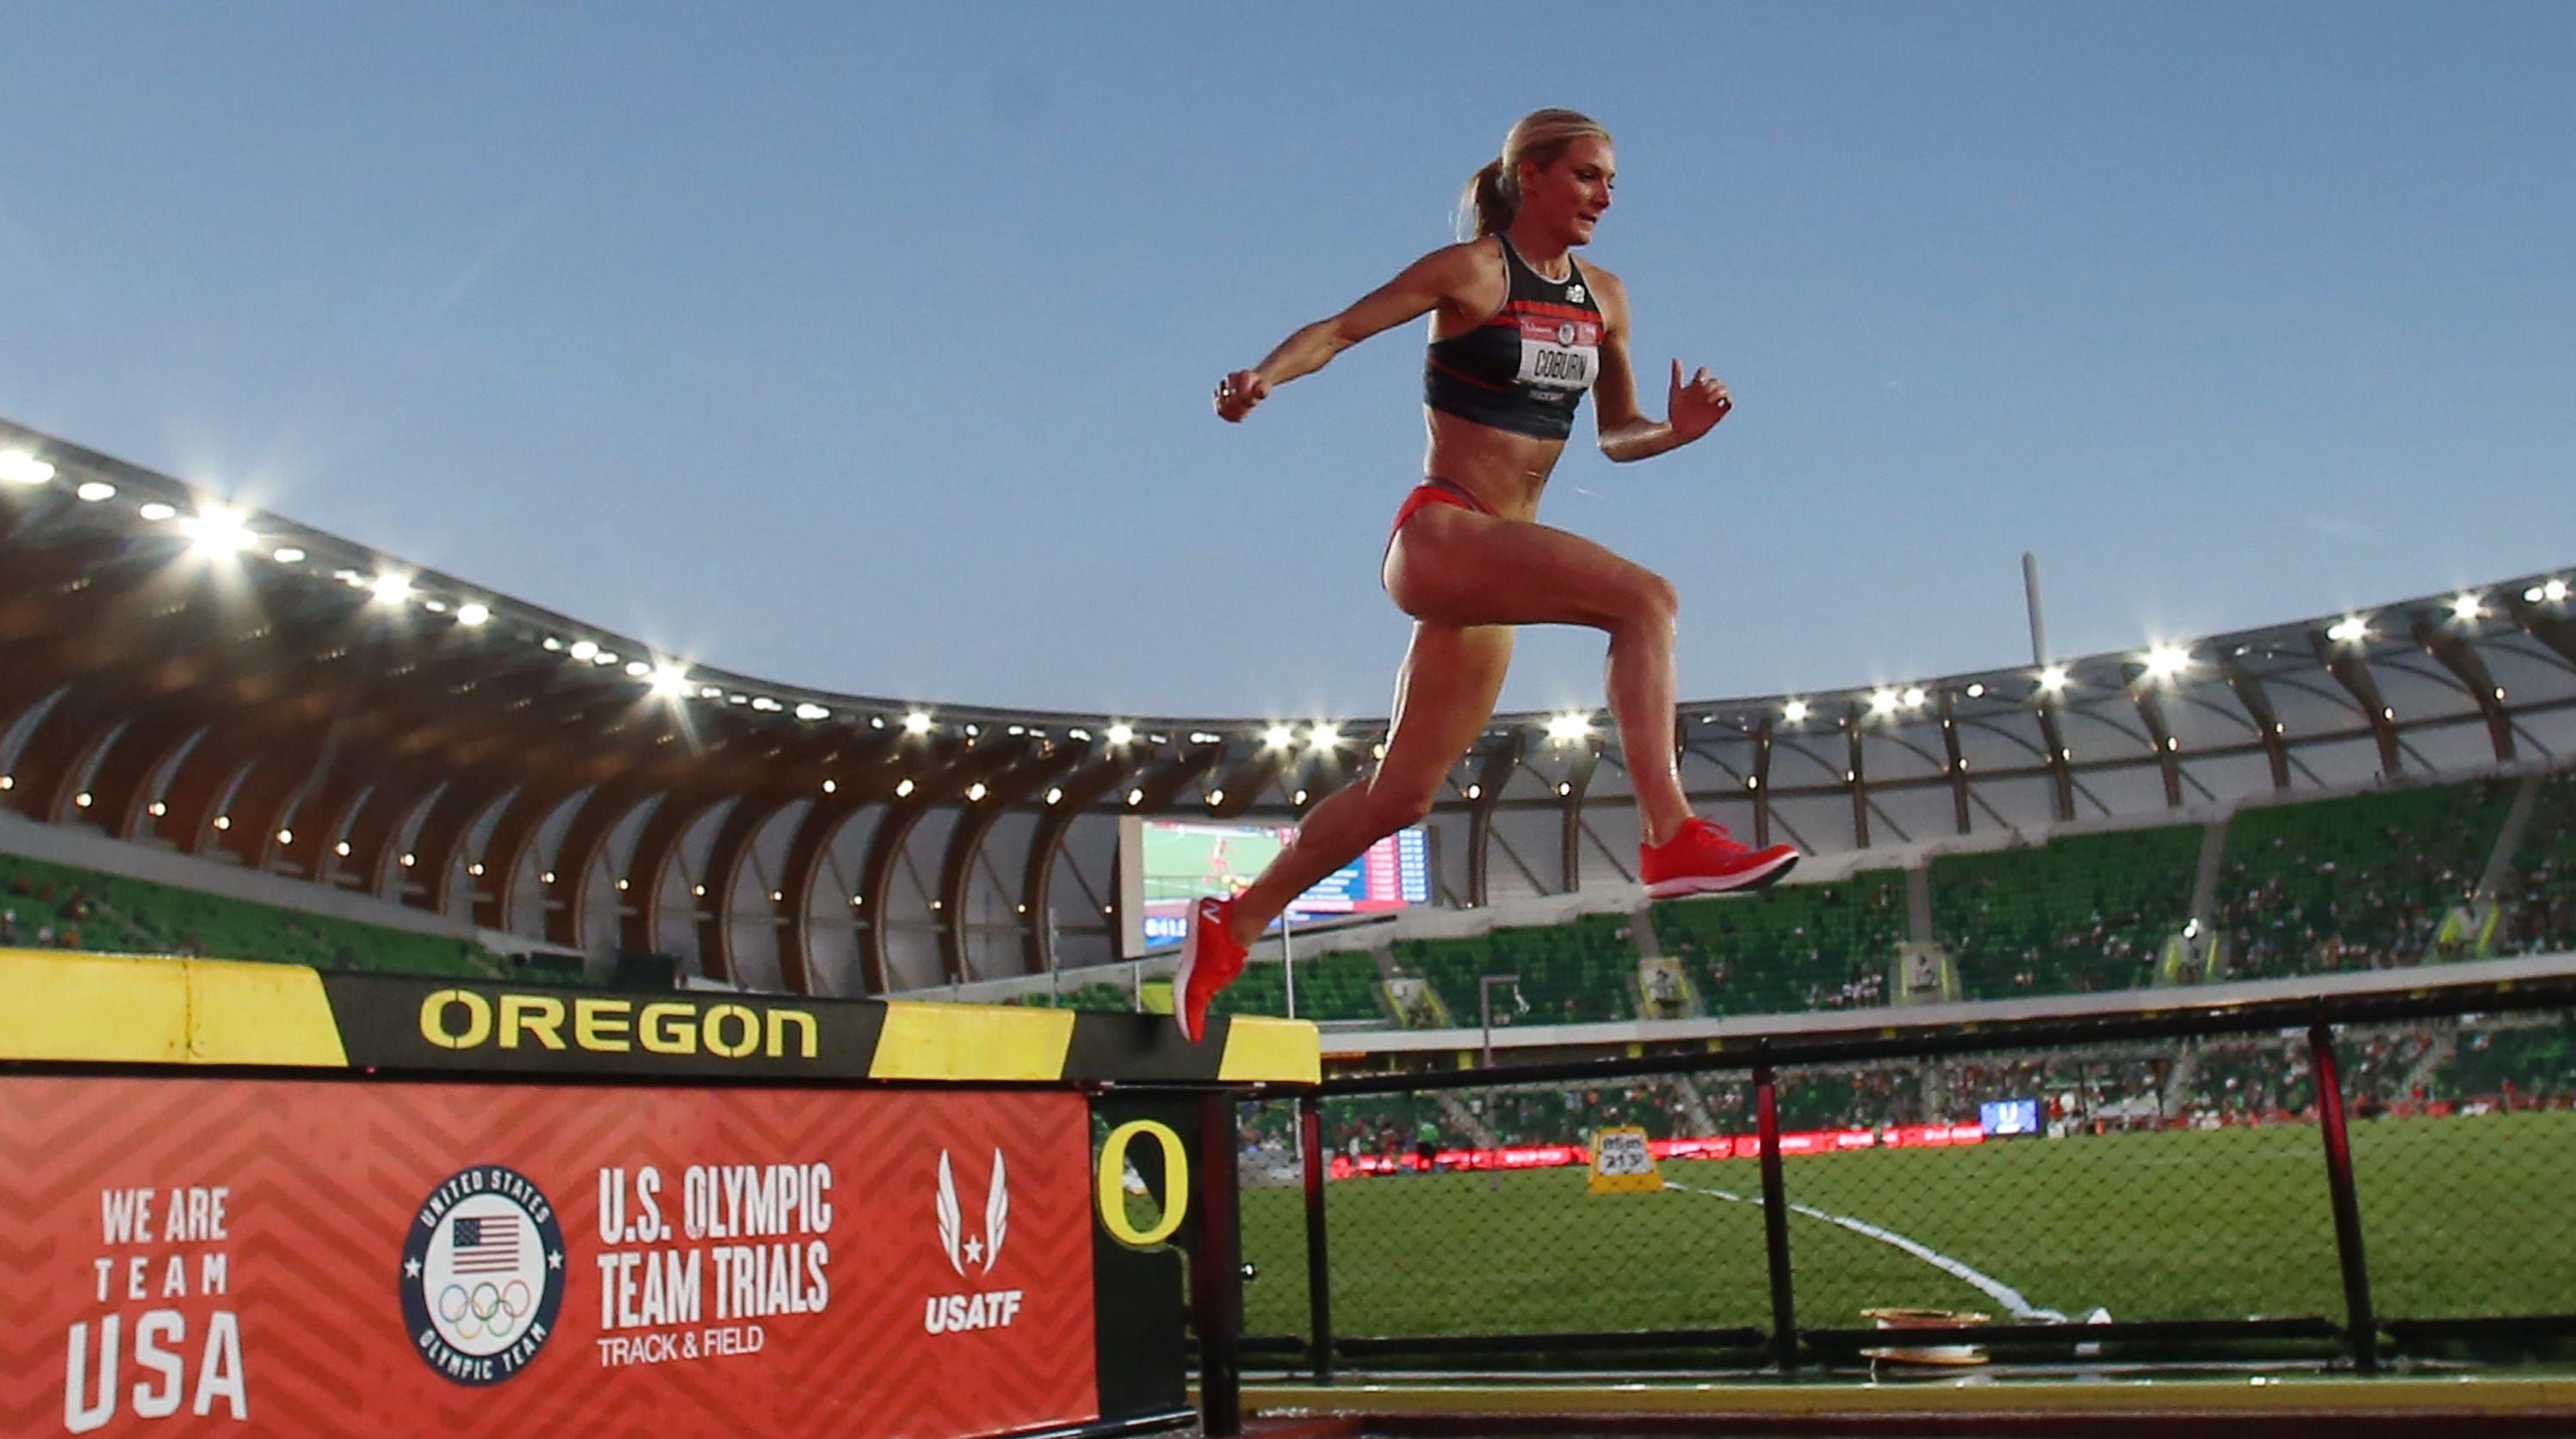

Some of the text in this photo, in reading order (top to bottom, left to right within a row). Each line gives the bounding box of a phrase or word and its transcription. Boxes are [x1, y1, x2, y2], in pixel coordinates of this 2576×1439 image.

[1534, 349, 1588, 381] COBURN
[101, 1186, 230, 1244] WE ARE
[419, 1169, 551, 1228] UNITED STATES
[598, 1163, 833, 1244] U.S. OLYMPIC
[95, 1253, 228, 1302] TEAM
[598, 1239, 829, 1330] TEAM TRIALS
[924, 1290, 1023, 1335] USATF
[64, 1310, 248, 1435] USA
[418, 1322, 548, 1380] OLYMPIC TEAM
[598, 1325, 765, 1367] TRACK & FIELD
